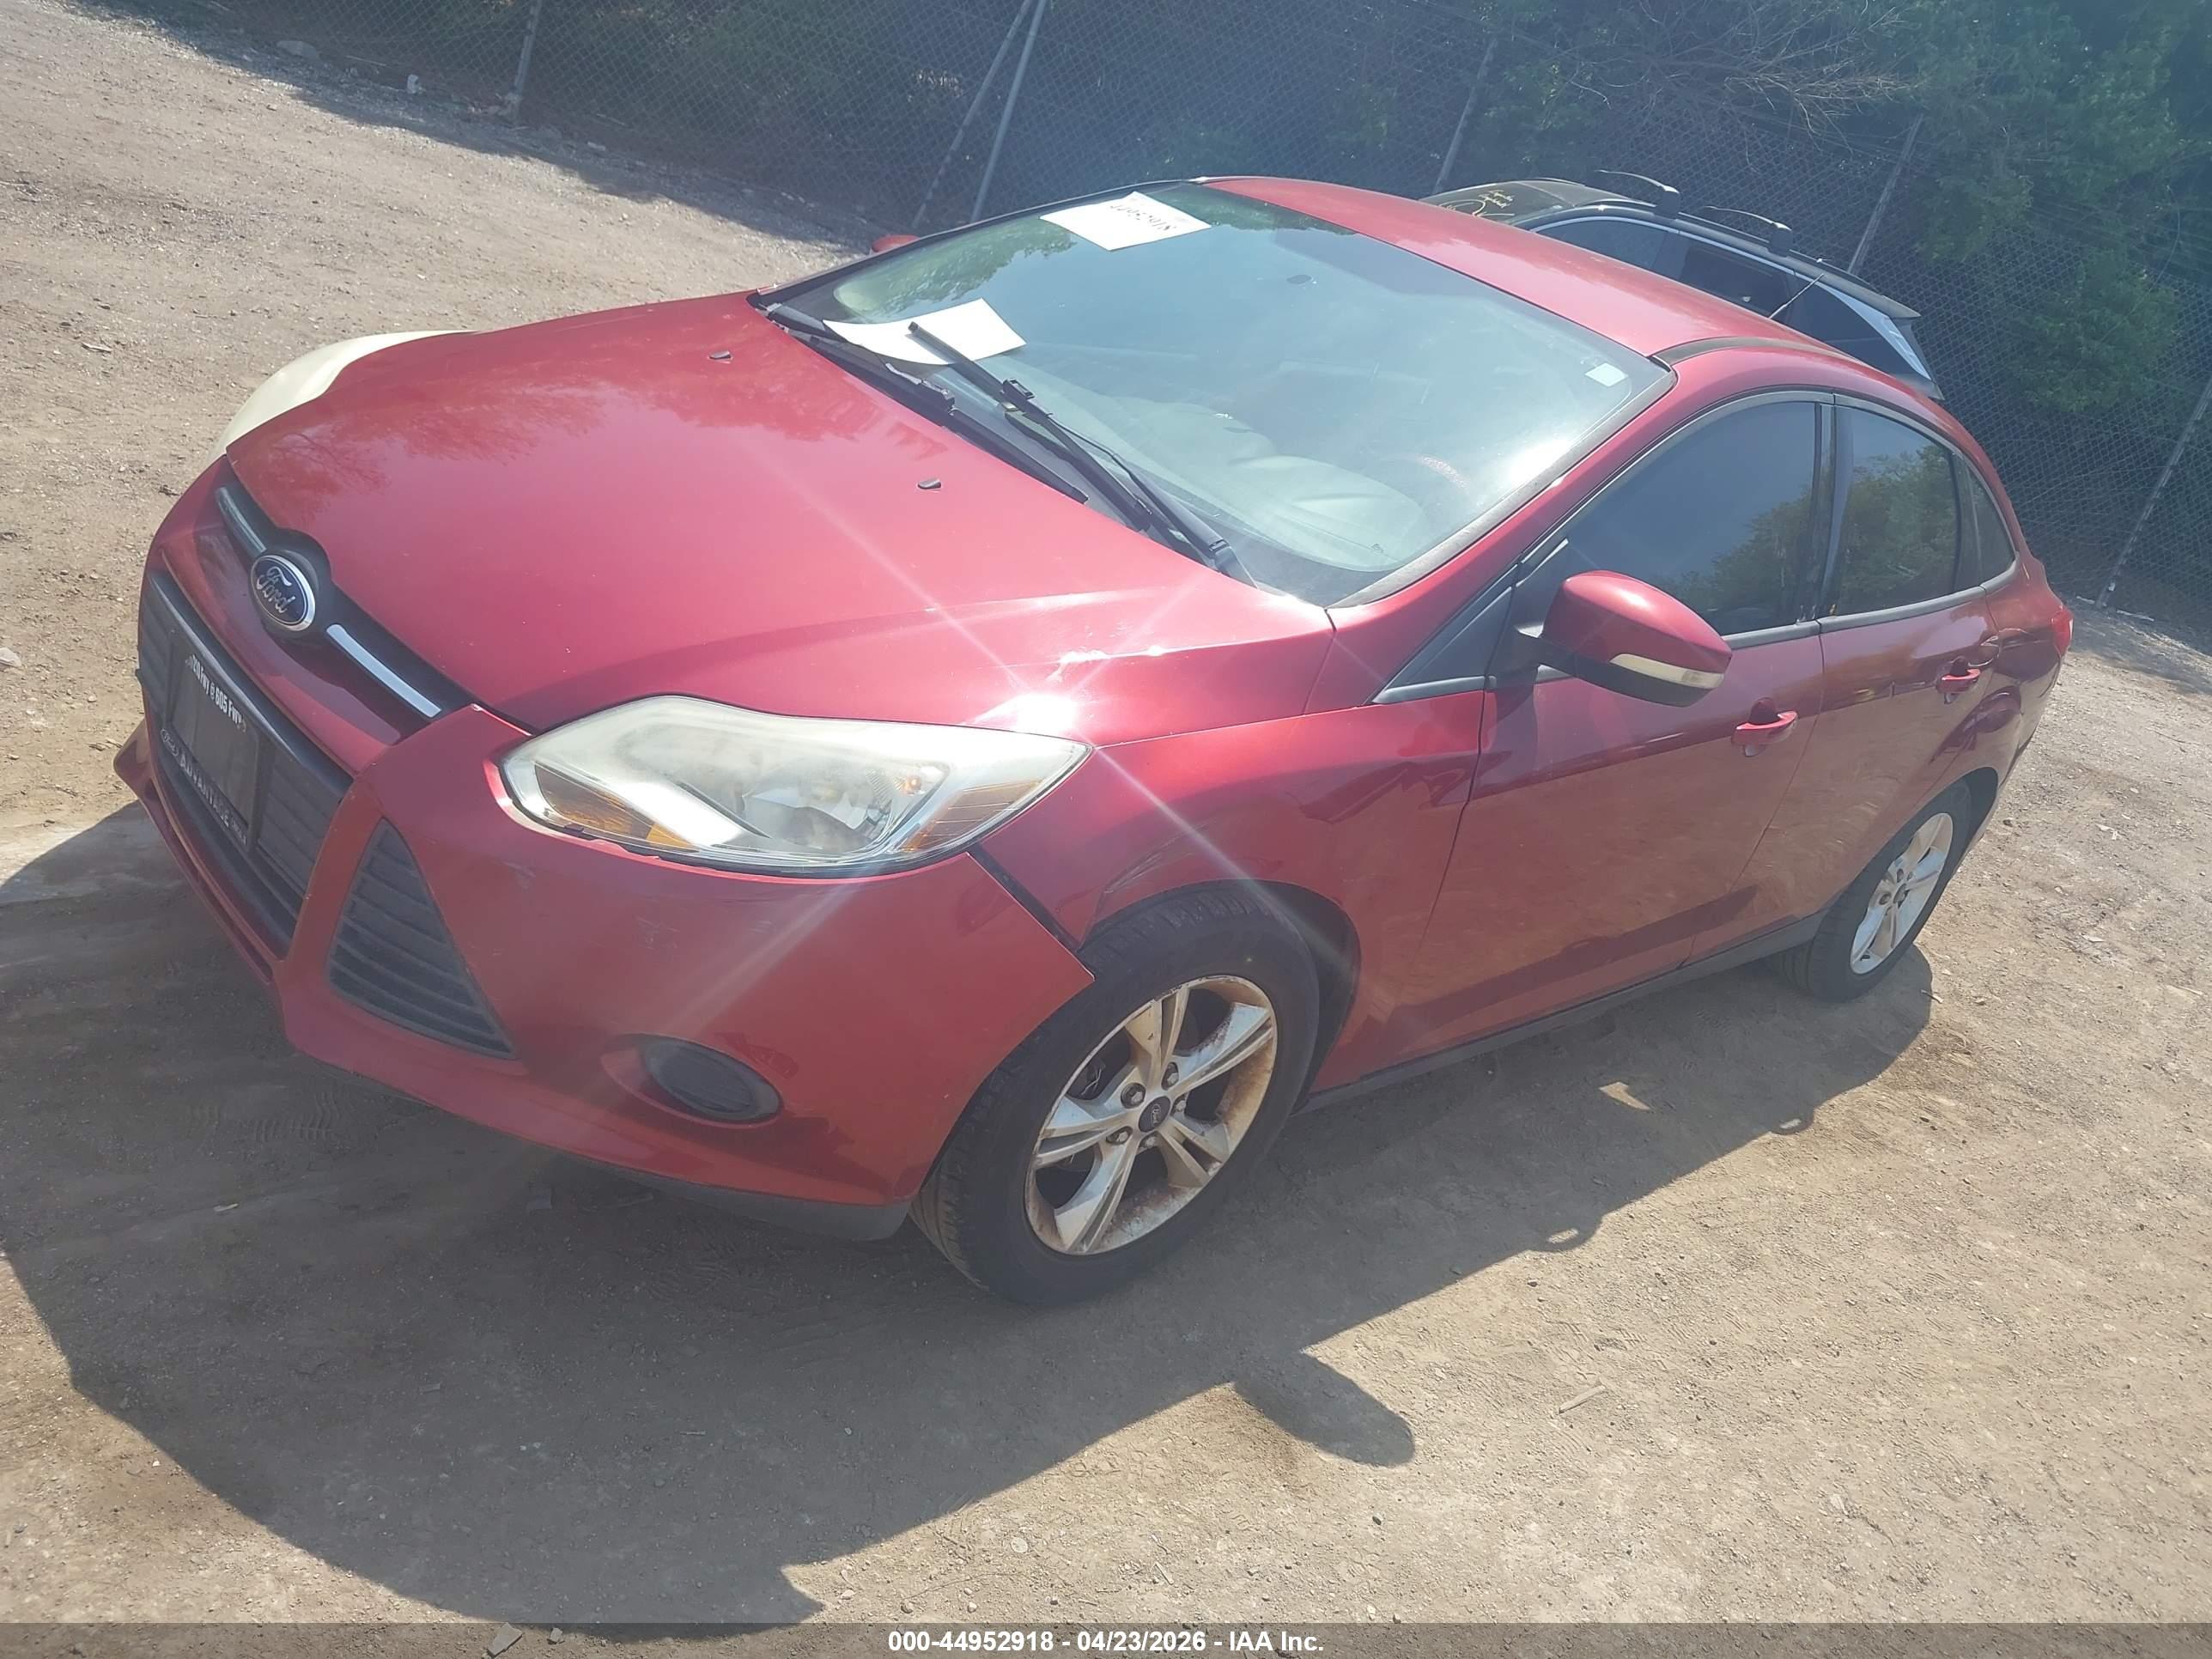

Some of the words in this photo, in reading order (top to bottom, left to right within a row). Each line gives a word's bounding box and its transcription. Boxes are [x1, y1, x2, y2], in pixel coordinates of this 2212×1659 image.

[256, 566, 296, 614] Ford
[200, 665, 211, 695] Fwy
[210, 682, 216, 701] @
[215, 686, 228, 714] 605
[228, 699, 242, 725] Fwy
